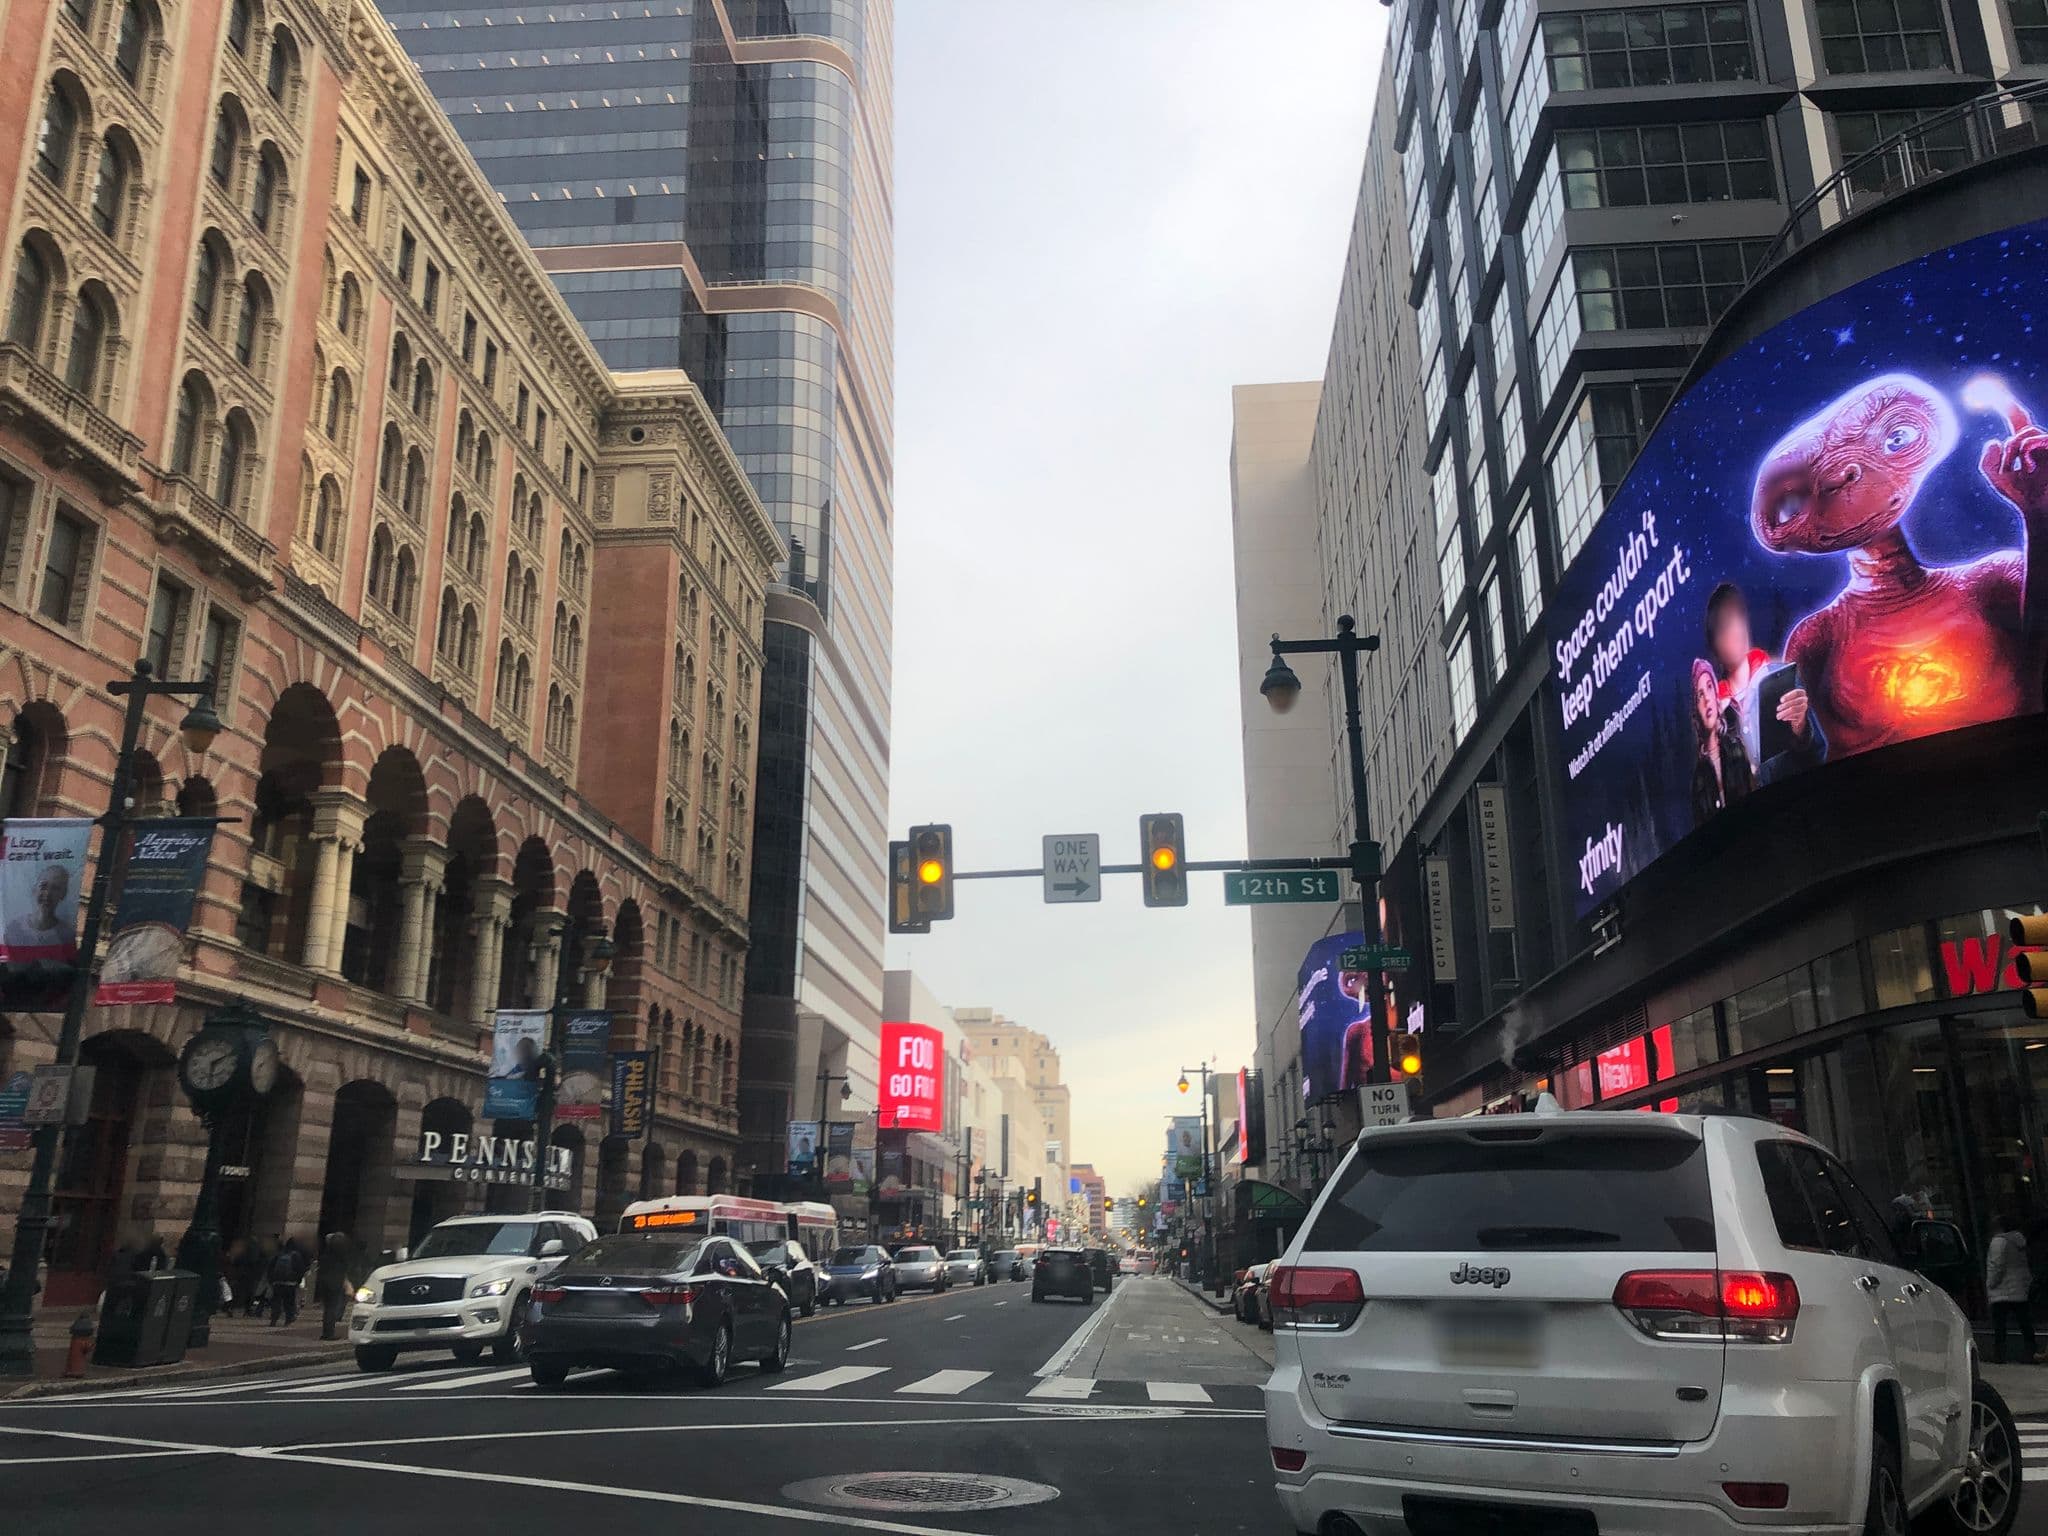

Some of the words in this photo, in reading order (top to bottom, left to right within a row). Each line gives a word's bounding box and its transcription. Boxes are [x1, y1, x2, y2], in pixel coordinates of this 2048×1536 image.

[1555, 607, 1596, 684] Space
[1595, 509, 1660, 624] couldn't
[1560, 691, 1594, 731] keep
[1592, 620, 1635, 690] them
[1634, 544, 1692, 639] apart.
[1568, 746, 1590, 780] Watch
[11, 837, 46, 849] Lizzy
[1053, 840, 1089, 857] ONE
[1482, 799, 1500, 870] FITNESS
[1053, 858, 1091, 874] WAY
[1578, 821, 1623, 895] xfinity
[1237, 878, 1291, 897] 12th
[1301, 876, 1327, 896] St
[1430, 870, 1443, 931] FITNESS
[1490, 875, 1503, 914] CITY
[1380, 955, 1412, 968] STREET
[1434, 936, 1447, 968] CITY
[1370, 1103, 1401, 1115] TURN
[1372, 1088, 1395, 1102] NO
[1449, 1261, 1511, 1289] Jeep
